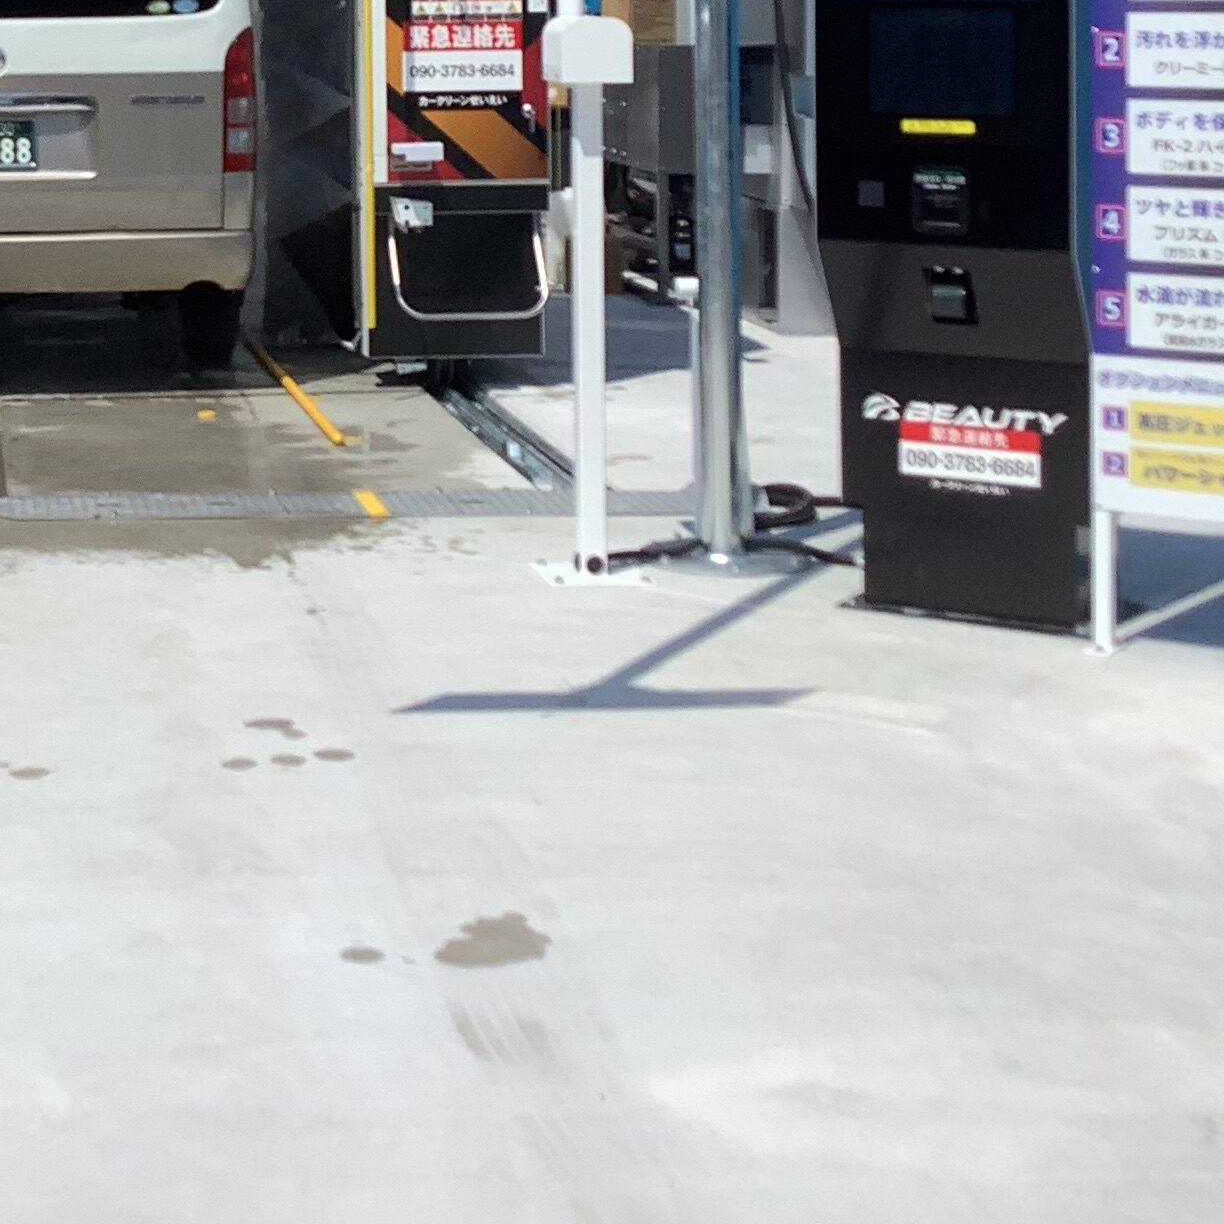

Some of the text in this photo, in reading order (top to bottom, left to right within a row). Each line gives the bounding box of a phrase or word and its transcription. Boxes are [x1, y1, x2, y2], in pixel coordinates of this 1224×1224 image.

[409, 25, 515, 49] 緊急連絡先
[1103, 36, 1119, 62] 2
[409, 62, 515, 78] 090-3783-6684
[1103, 123, 1120, 148] 3
[1102, 209, 1120, 235] 4
[1103, 295, 1121, 321] 5
[903, 400, 1068, 435] BEAUTY
[906, 448, 1035, 478] 090-3783-6684
